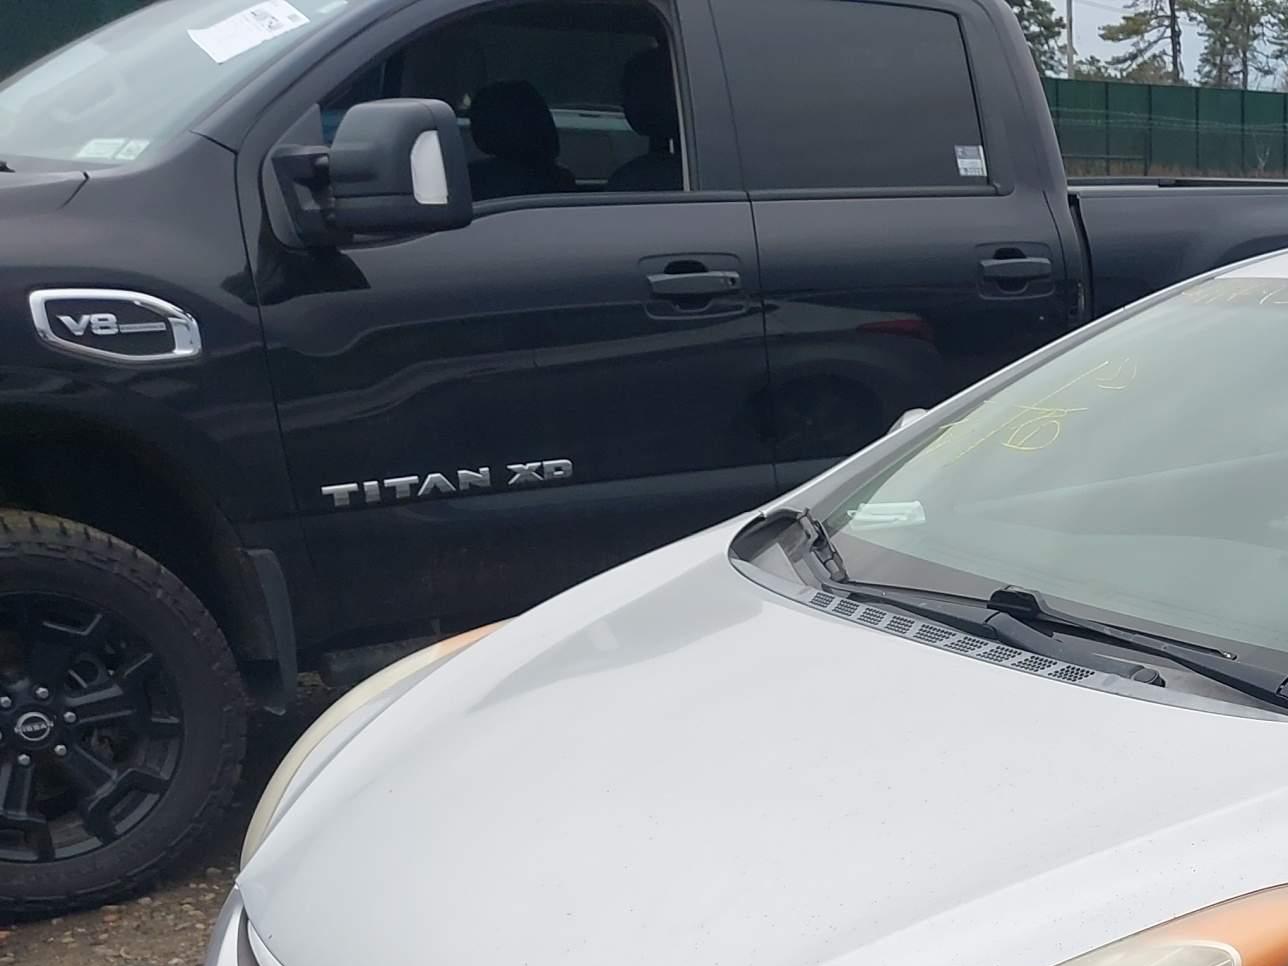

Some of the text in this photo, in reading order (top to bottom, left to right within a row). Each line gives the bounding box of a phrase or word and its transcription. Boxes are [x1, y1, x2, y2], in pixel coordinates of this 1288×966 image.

[56, 313, 118, 336] V8
[321, 459, 574, 507] TITAN XD
